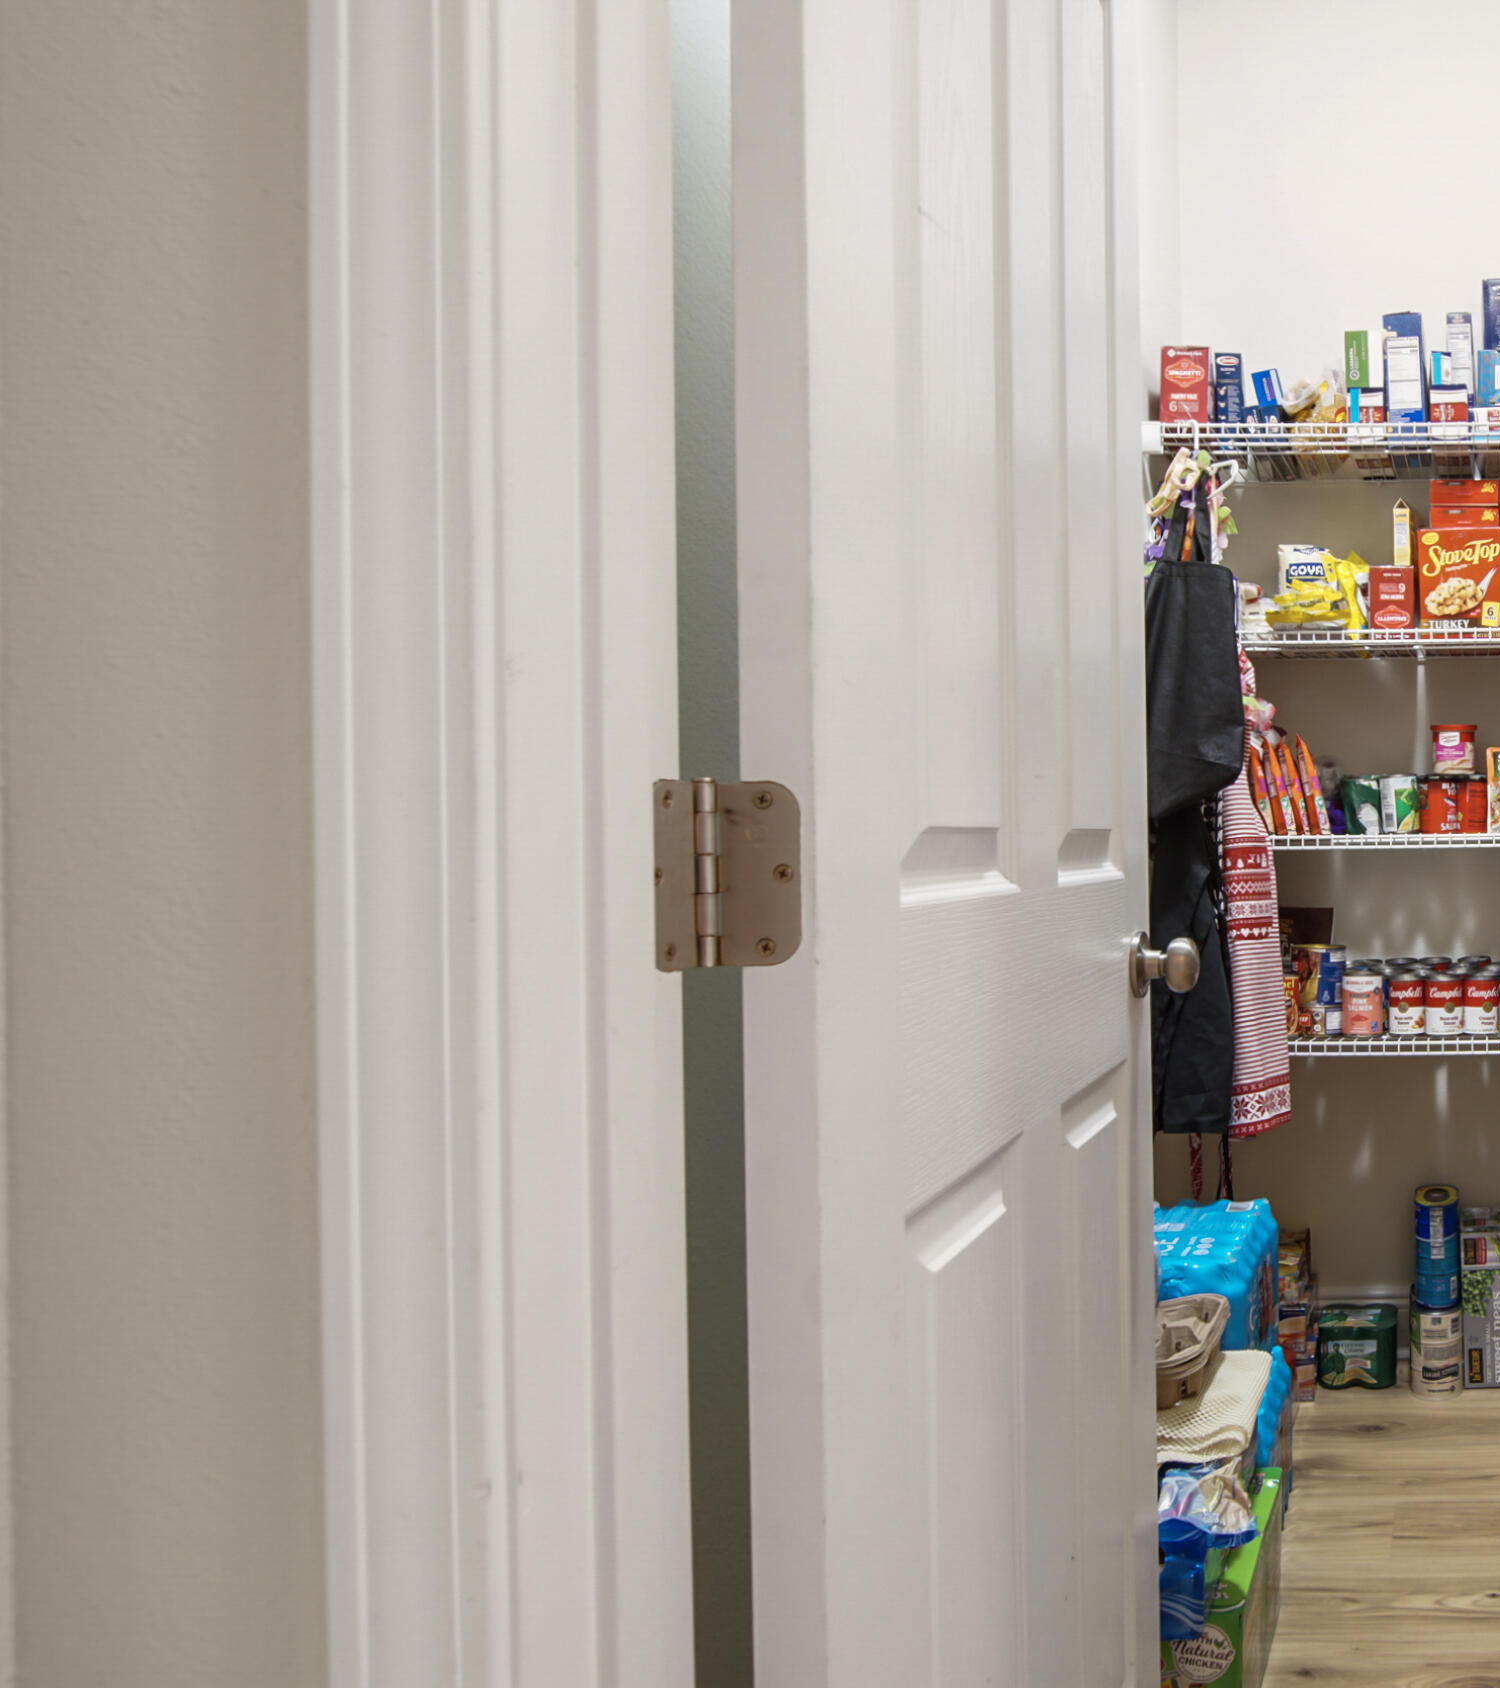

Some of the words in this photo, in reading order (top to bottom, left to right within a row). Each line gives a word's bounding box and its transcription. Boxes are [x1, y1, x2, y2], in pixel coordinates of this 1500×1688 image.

[1168, 401, 1178, 412] 6
[1290, 564, 1324, 577] GOYA
[1487, 606, 1494, 617] 6
[1429, 619, 1470, 629] TURKEY
[1172, 1640, 1234, 1661] Natural
[1178, 1656, 1224, 1670] CHICKEN
